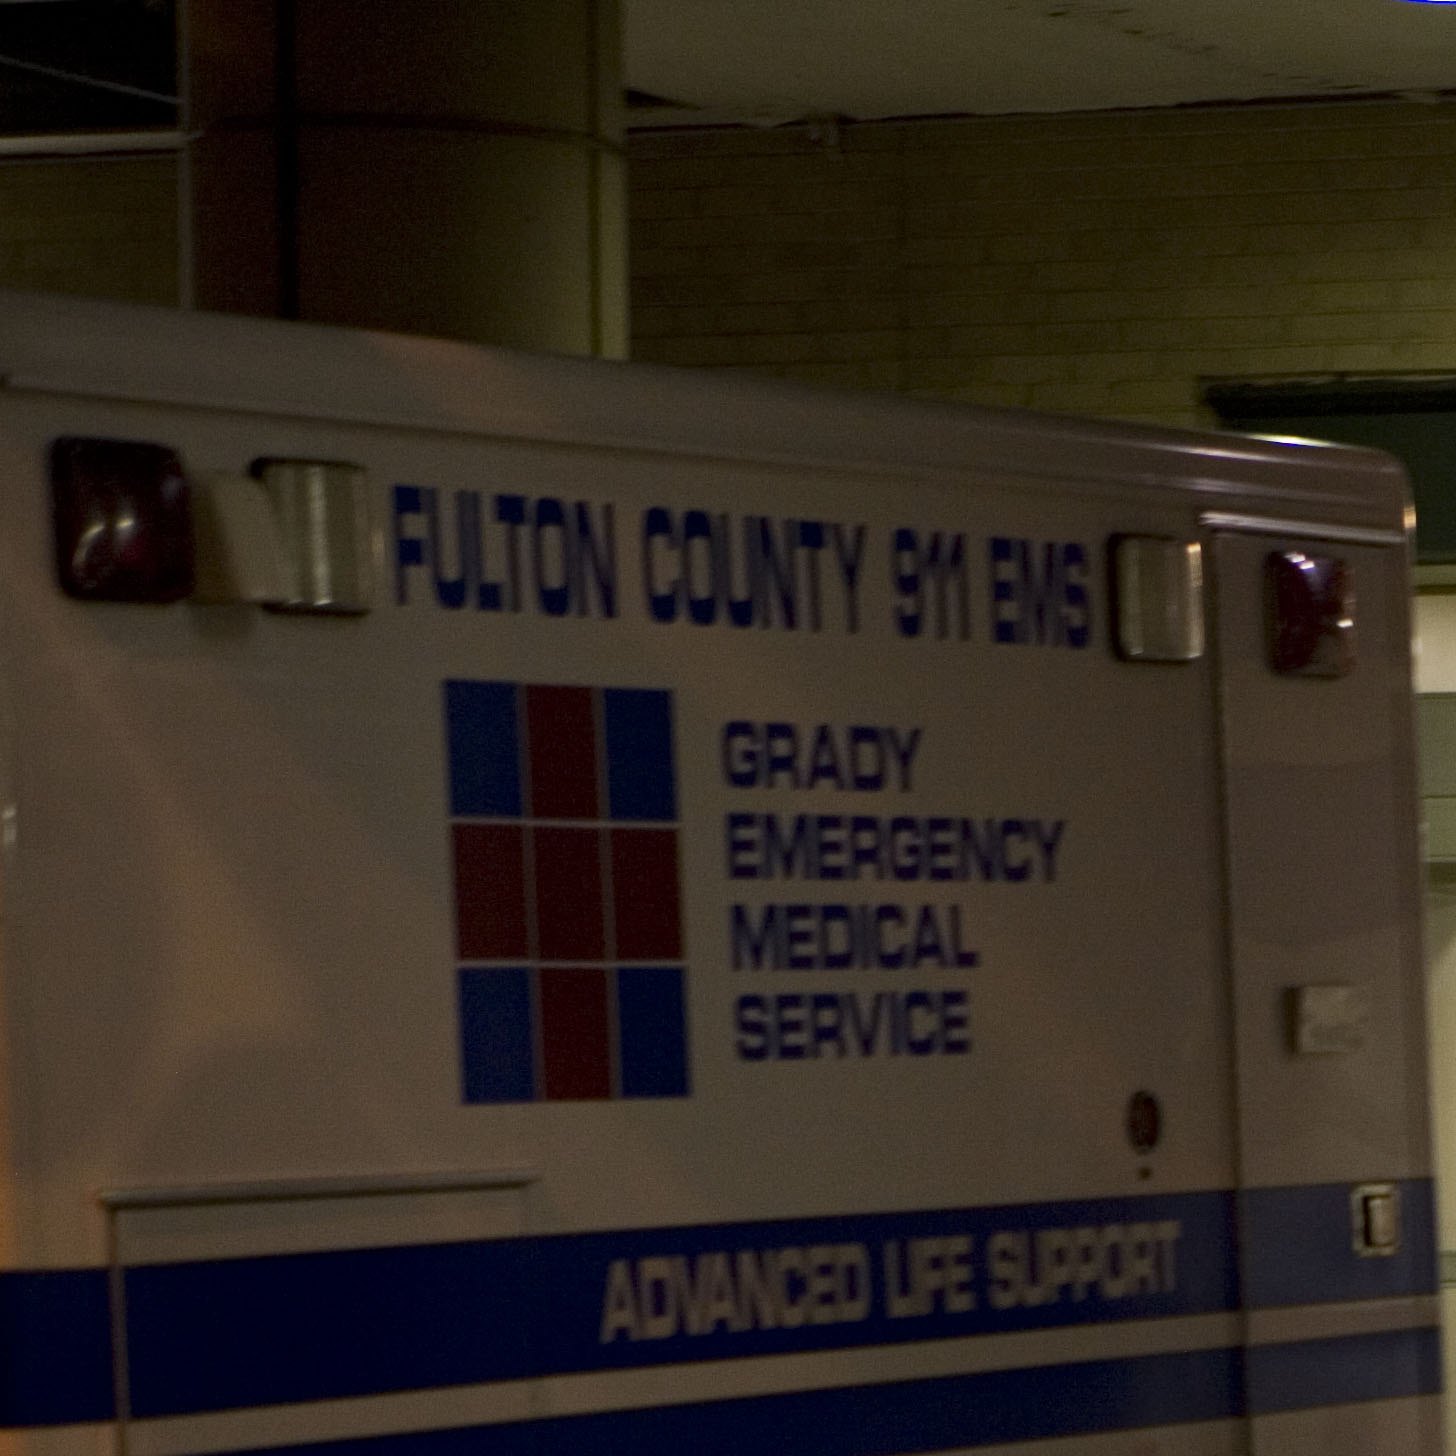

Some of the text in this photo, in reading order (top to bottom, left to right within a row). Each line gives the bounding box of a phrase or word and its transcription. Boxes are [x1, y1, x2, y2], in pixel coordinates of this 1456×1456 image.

[390, 484, 1092, 652] FULTON COUNTY 911 EMS
[722, 719, 923, 793] GRADY
[726, 812, 1066, 884] EMERGENCY
[730, 902, 980, 972] MEDICAL
[735, 989, 972, 1063] SERVICE
[602, 1219, 1184, 1344] ADVANCED LIFE SUPPORT
